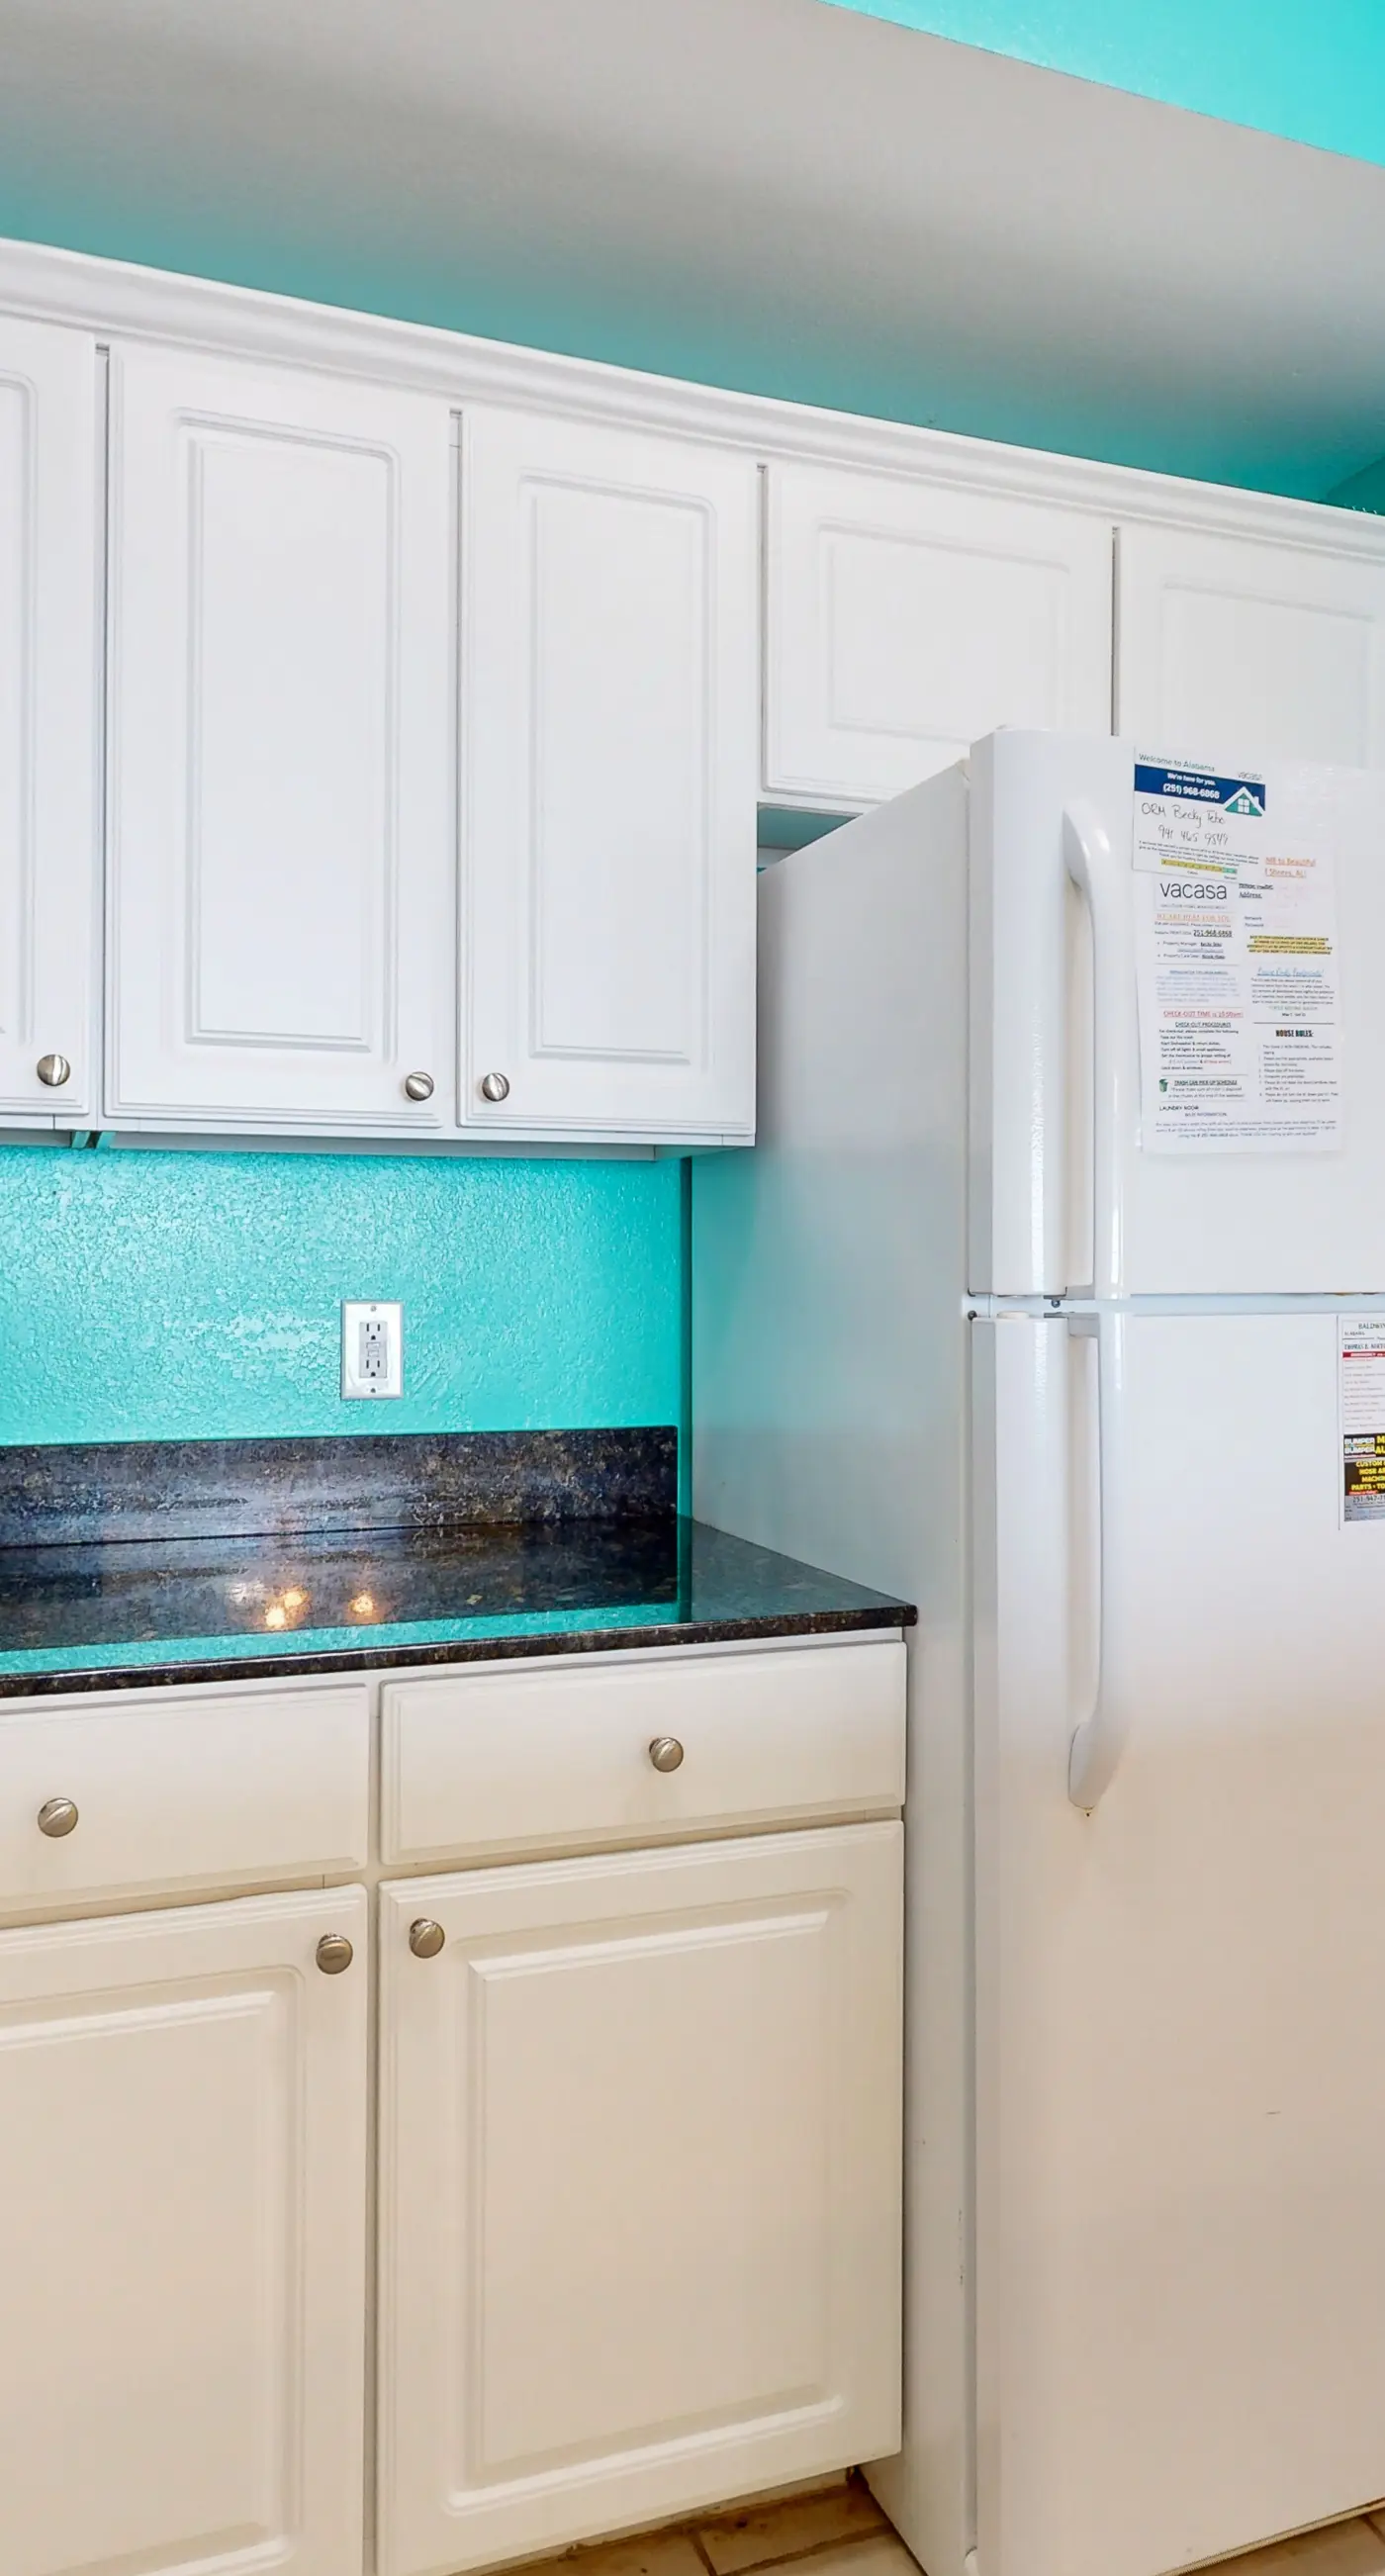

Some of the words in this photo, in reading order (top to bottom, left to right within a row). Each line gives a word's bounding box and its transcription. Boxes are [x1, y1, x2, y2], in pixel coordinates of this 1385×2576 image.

[1139, 753, 1172, 767] Welcome
[1183, 760, 1215, 772] Alabama
[1162, 782, 1182, 795] (251)
[1171, 804, 1202, 829] Becky
[1159, 882, 1227, 899] vacasa
